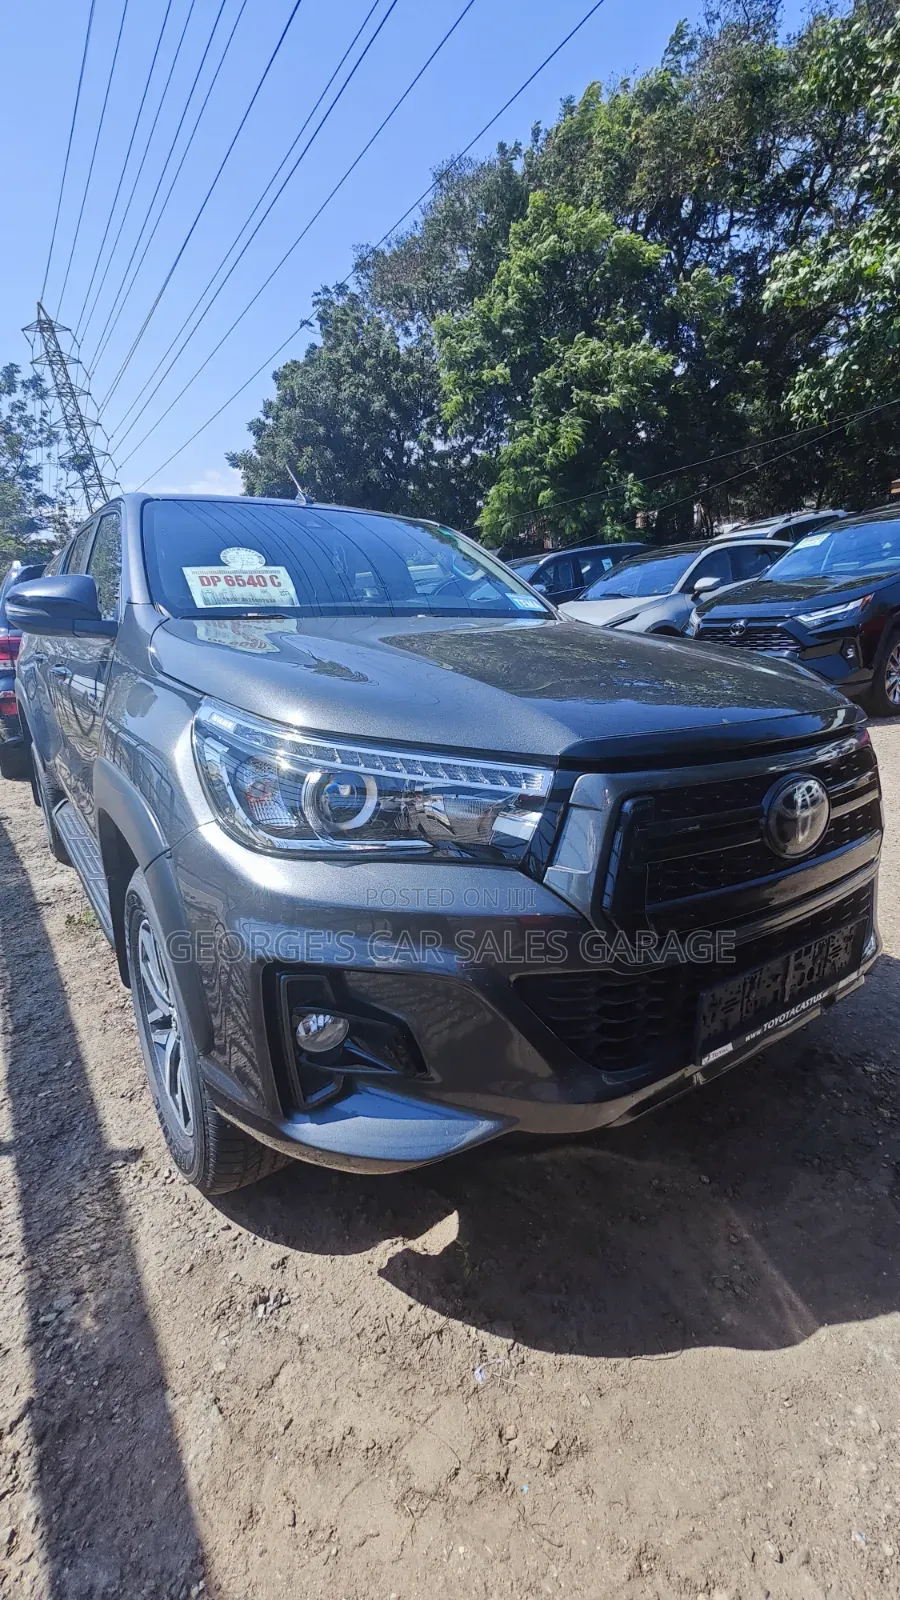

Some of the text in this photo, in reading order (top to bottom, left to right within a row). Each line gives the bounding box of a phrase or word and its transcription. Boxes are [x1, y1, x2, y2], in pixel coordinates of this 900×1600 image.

[199, 574, 282, 588] DP 6540 C
[745, 990, 829, 1042] www.TOYOTACASTUS.
